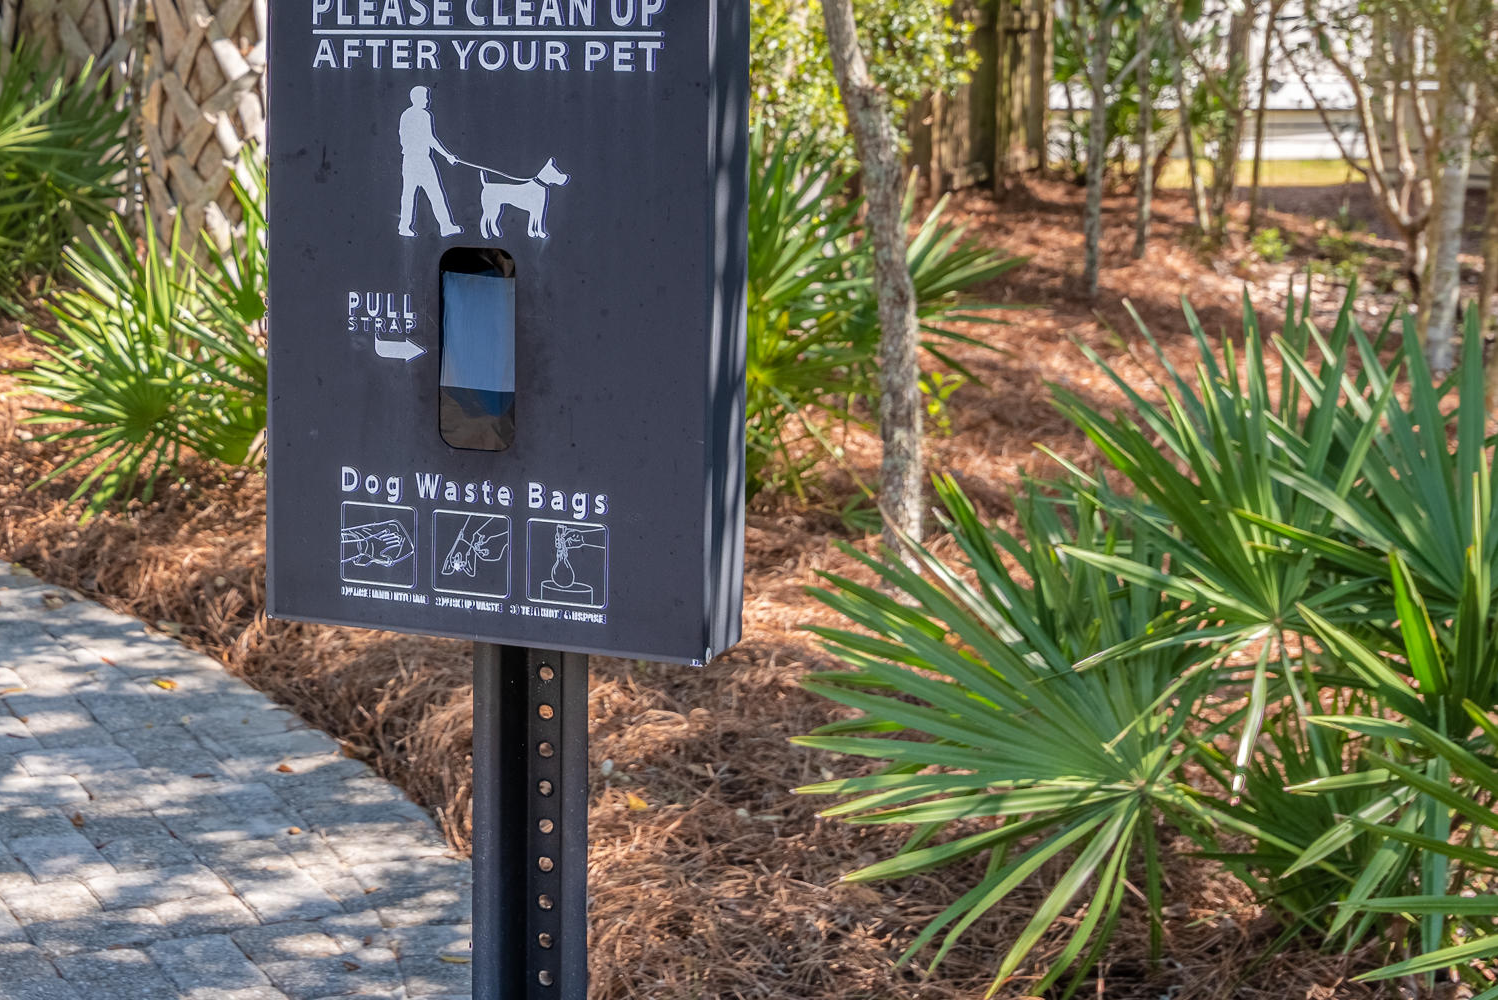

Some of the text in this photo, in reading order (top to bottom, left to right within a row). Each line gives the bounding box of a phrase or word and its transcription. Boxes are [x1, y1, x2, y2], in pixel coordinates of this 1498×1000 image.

[312, 39, 664, 72] AFTER YOUR PET
[348, 291, 416, 319] PULL
[348, 316, 416, 333] STRAP
[341, 466, 609, 519] Dog Waste Bags
